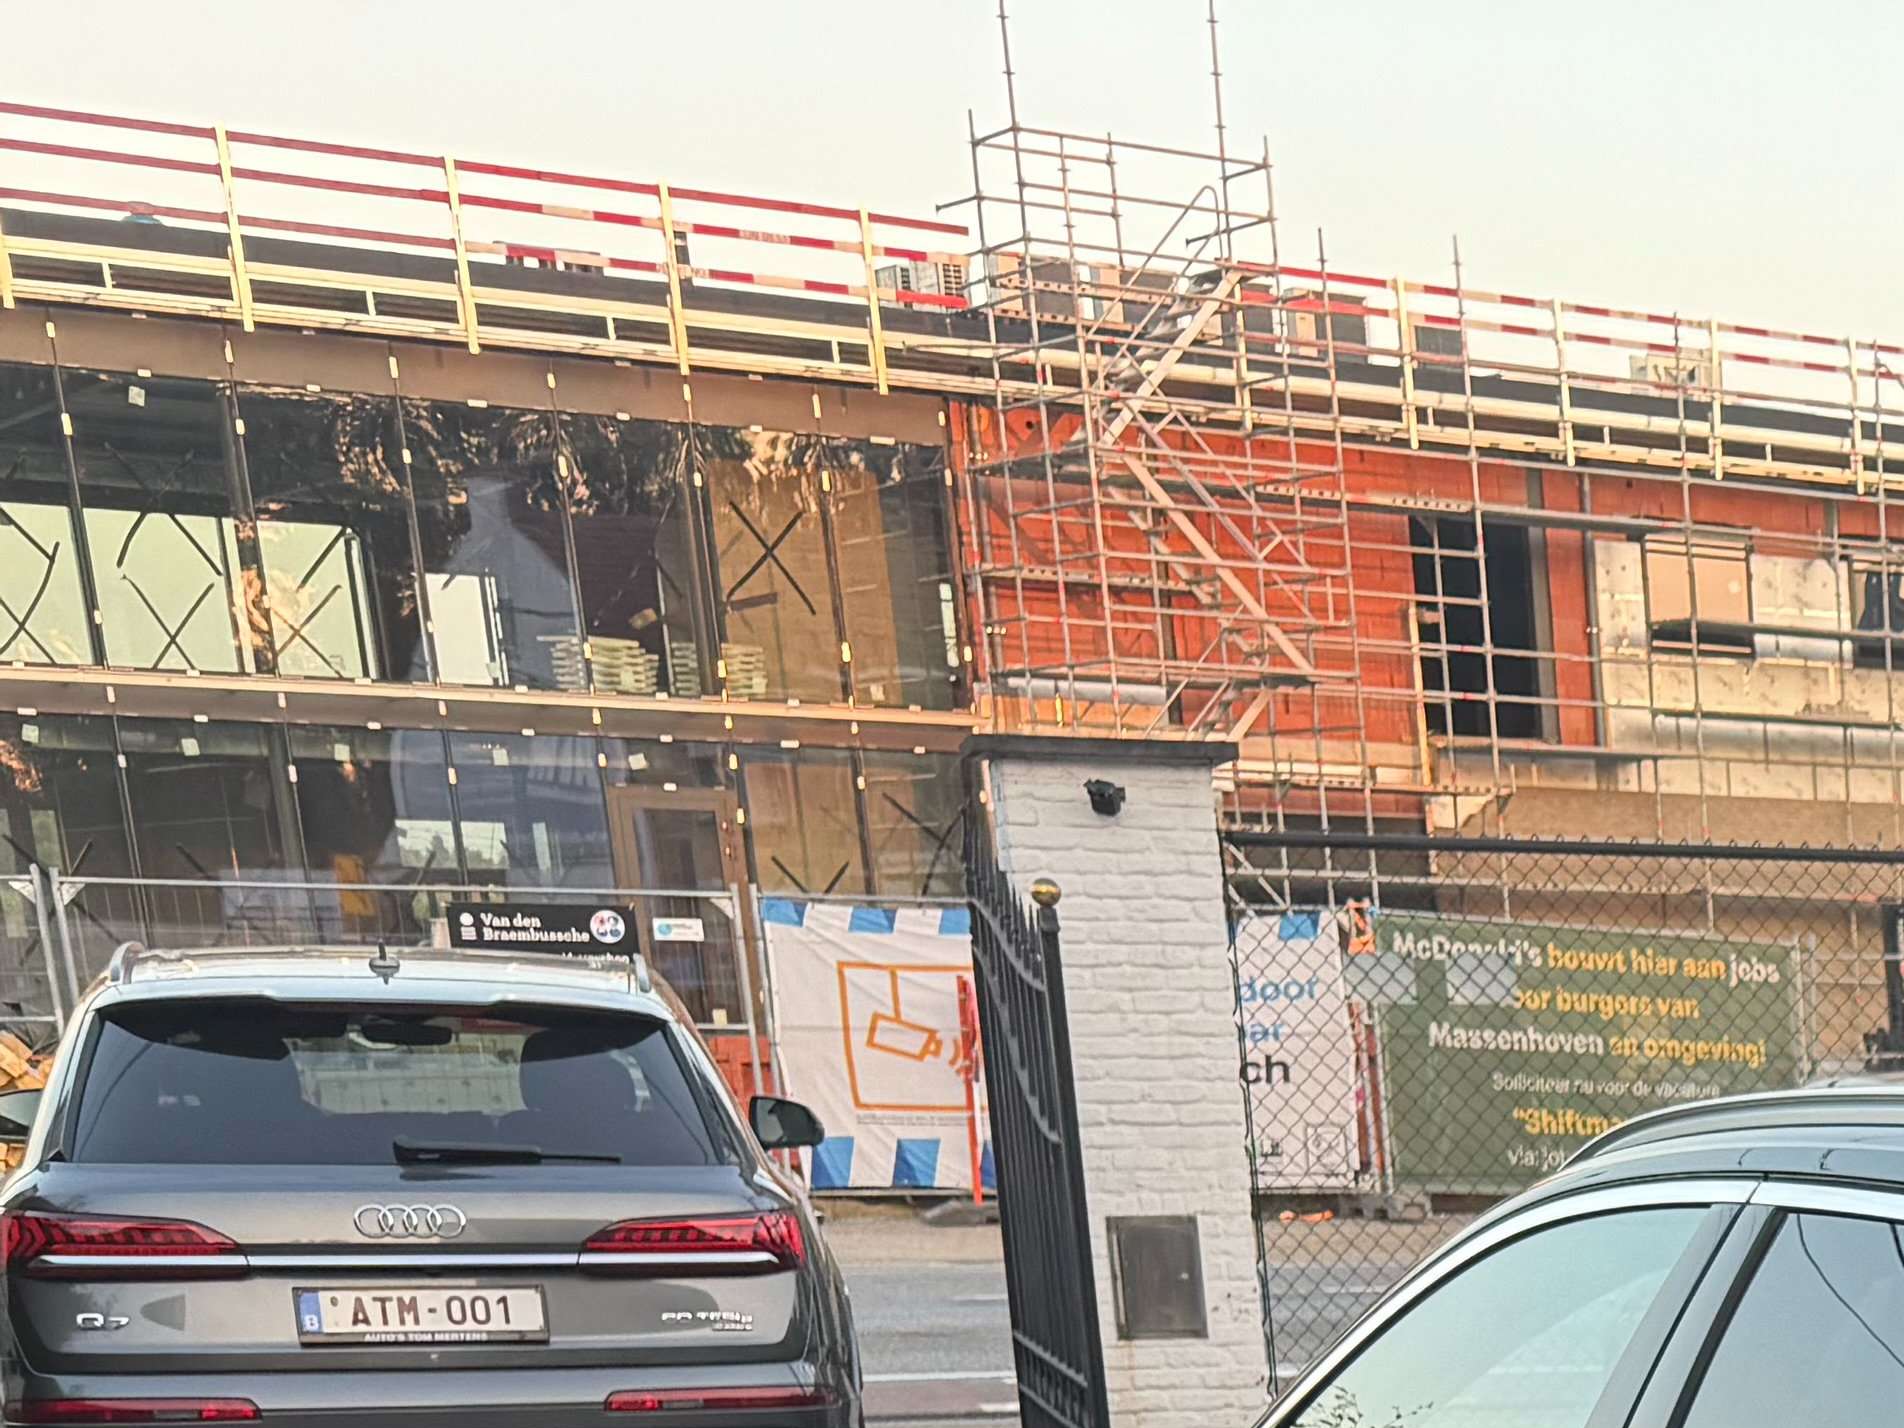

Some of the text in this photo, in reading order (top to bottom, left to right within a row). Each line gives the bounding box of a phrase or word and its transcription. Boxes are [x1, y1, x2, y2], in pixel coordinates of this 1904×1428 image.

[481, 912, 541, 928] Van den
[1631, 948, 1678, 976] hier
[1729, 953, 1780, 987] jobs
[1428, 1021, 1604, 1055] Massenhoven
